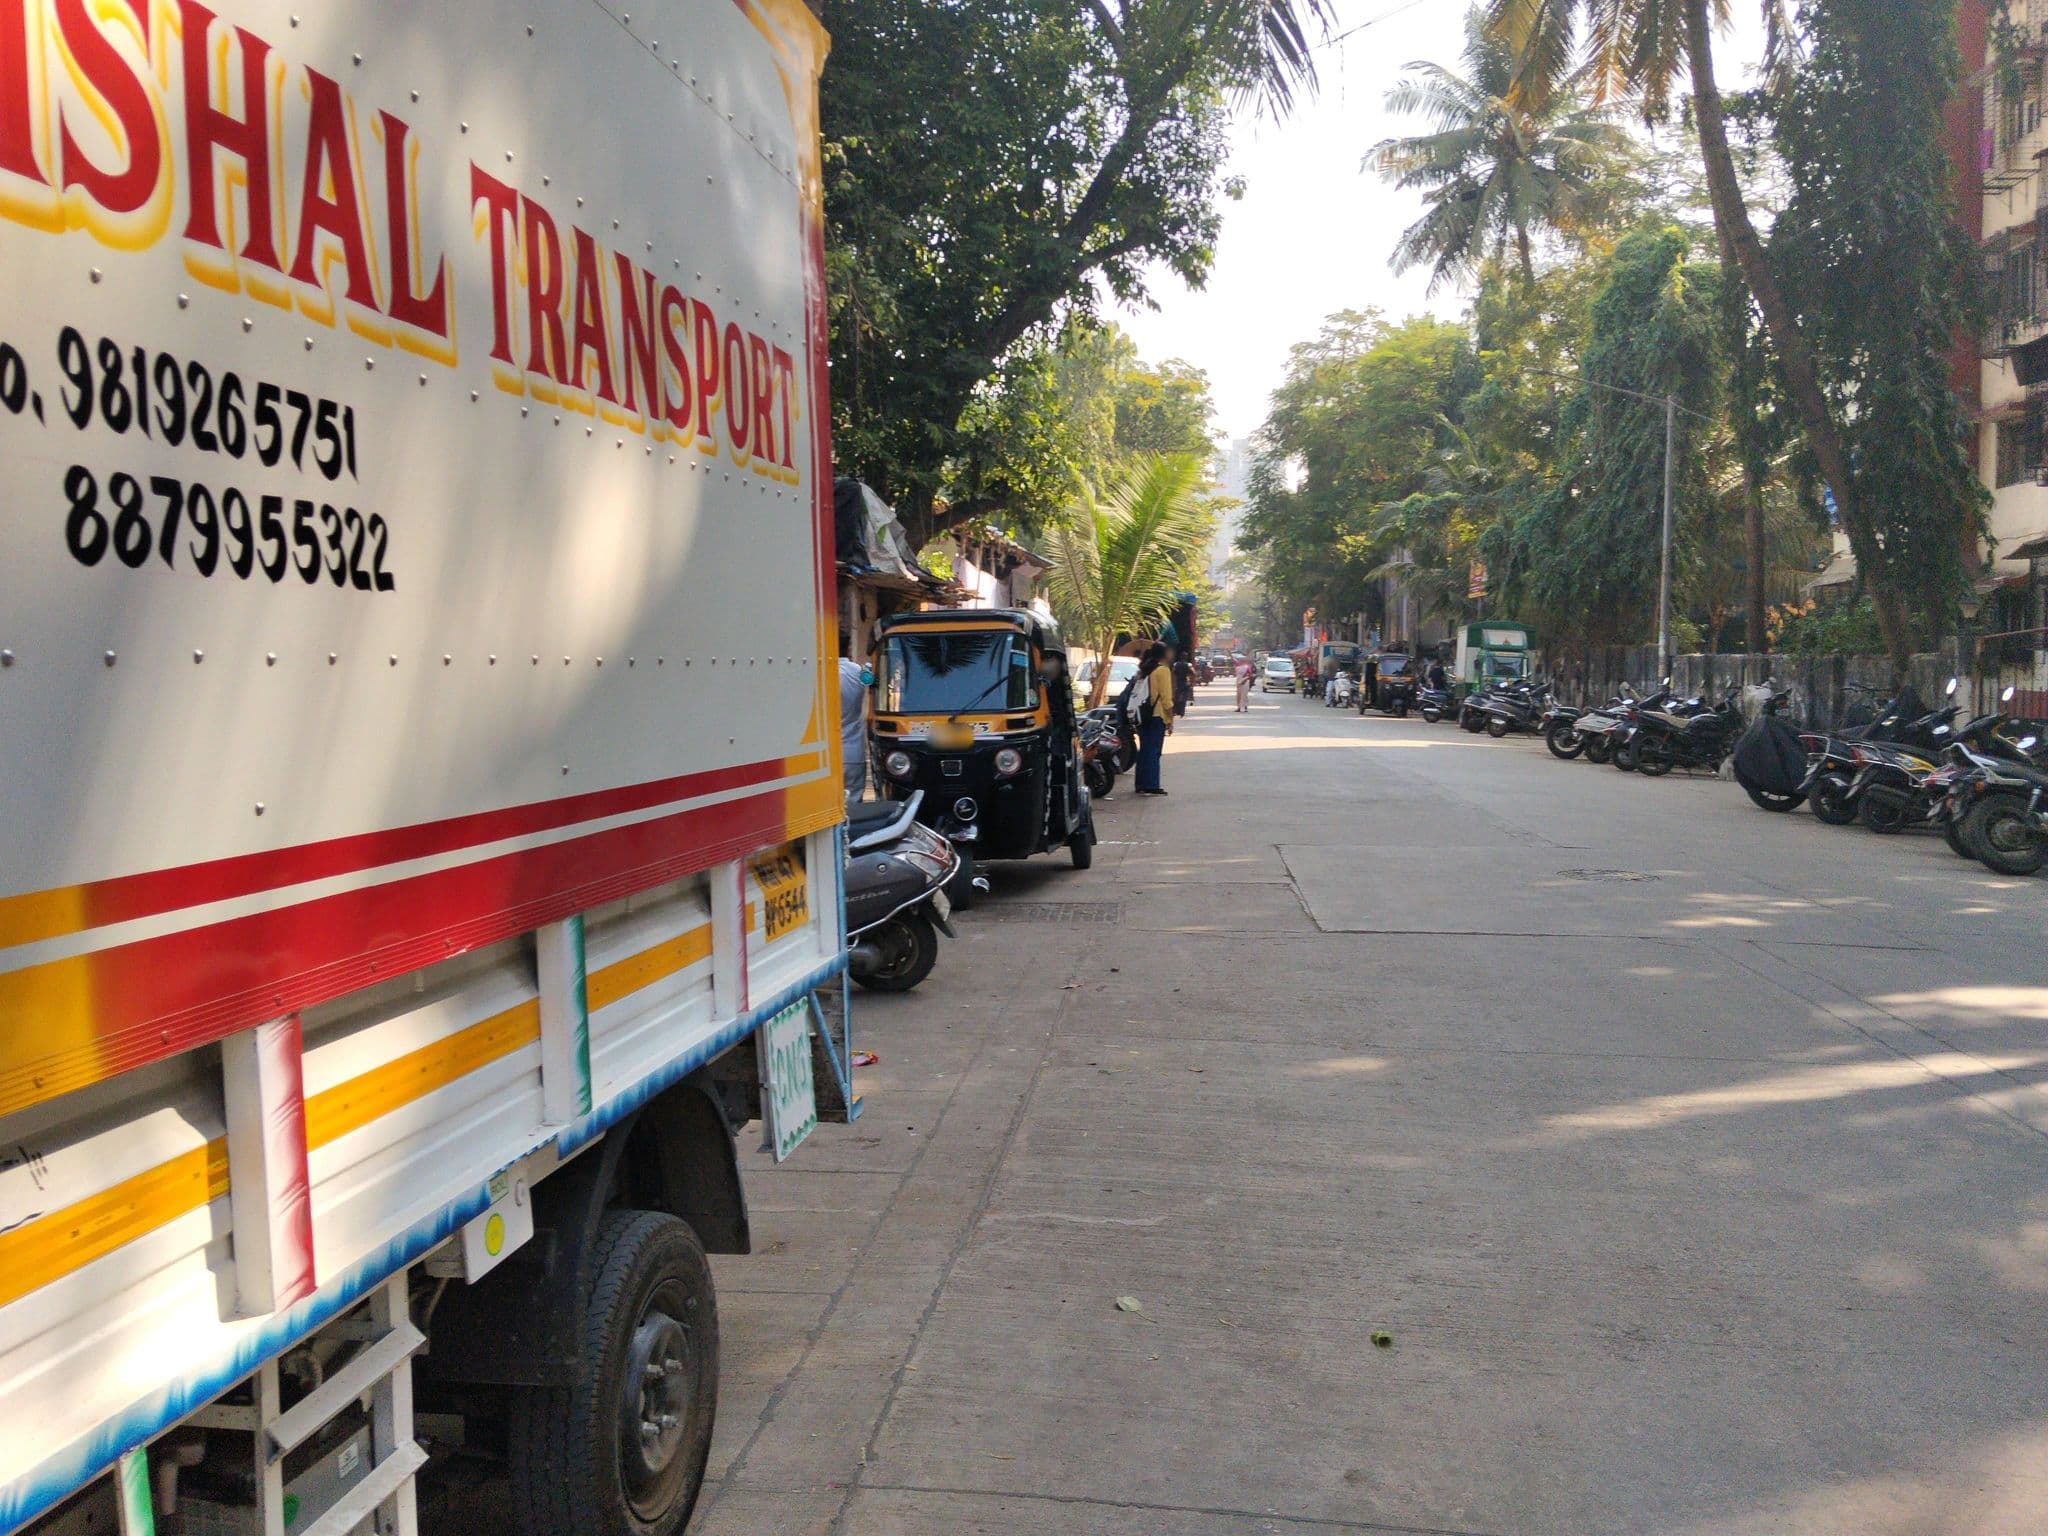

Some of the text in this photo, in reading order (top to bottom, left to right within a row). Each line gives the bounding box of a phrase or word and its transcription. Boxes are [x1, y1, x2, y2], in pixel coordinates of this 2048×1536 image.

[469, 158, 797, 471] TRANSPORT
[58, 325, 359, 484] 9819265751
[64, 464, 395, 591] 8879955322
